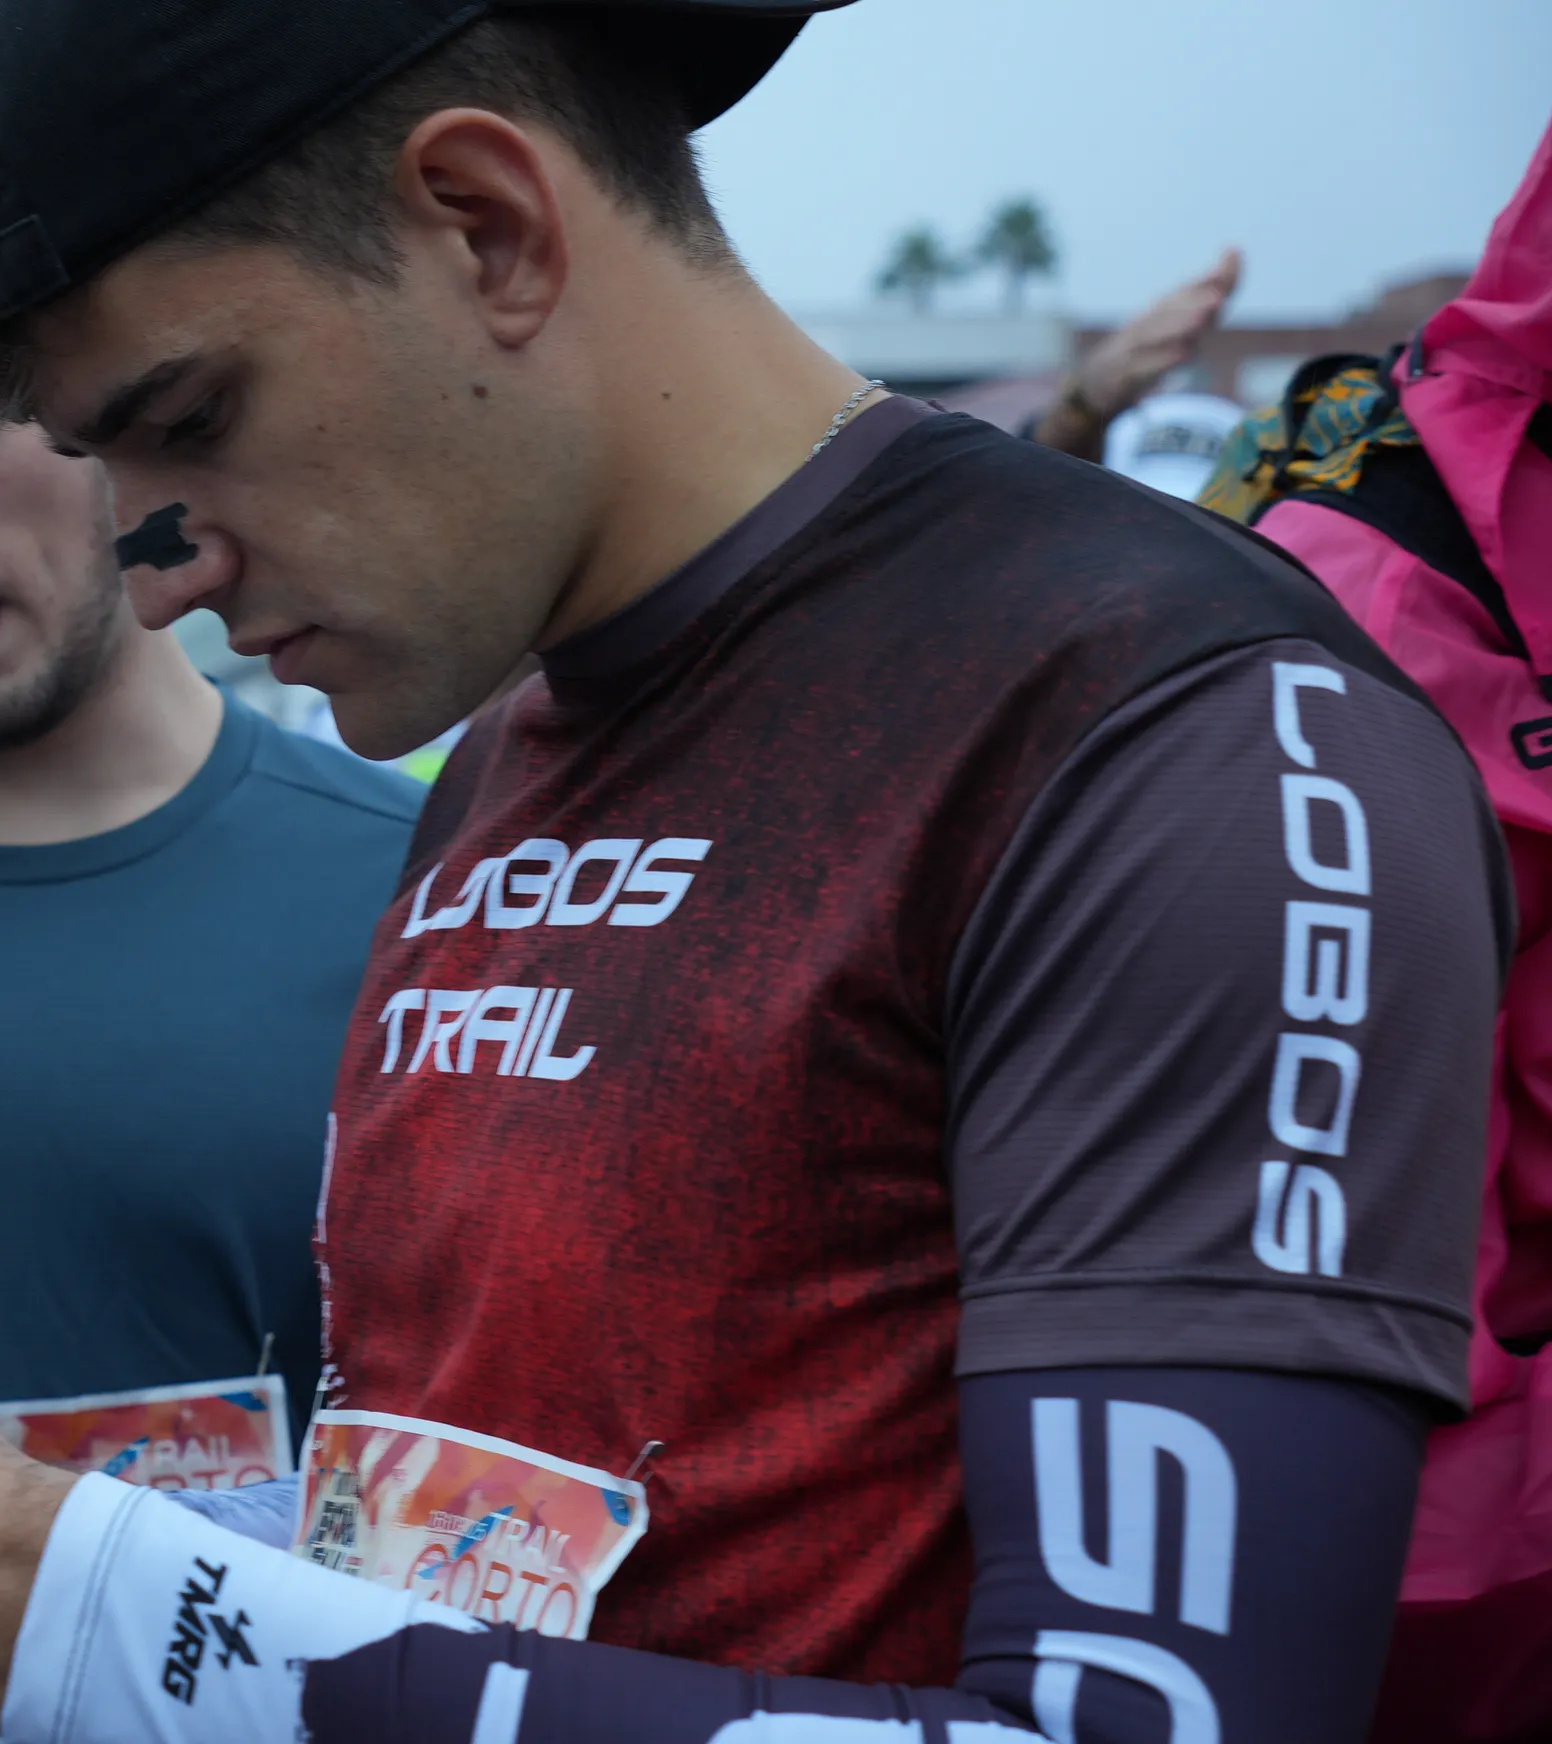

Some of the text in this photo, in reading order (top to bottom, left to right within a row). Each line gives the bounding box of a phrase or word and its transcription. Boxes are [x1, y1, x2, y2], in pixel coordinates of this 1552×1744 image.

[401, 837, 714, 939] LOBOS
[1251, 661, 1373, 1278] LOBOS
[378, 985, 598, 1081] TRAIL
[162, 1556, 229, 1707] TMRG
